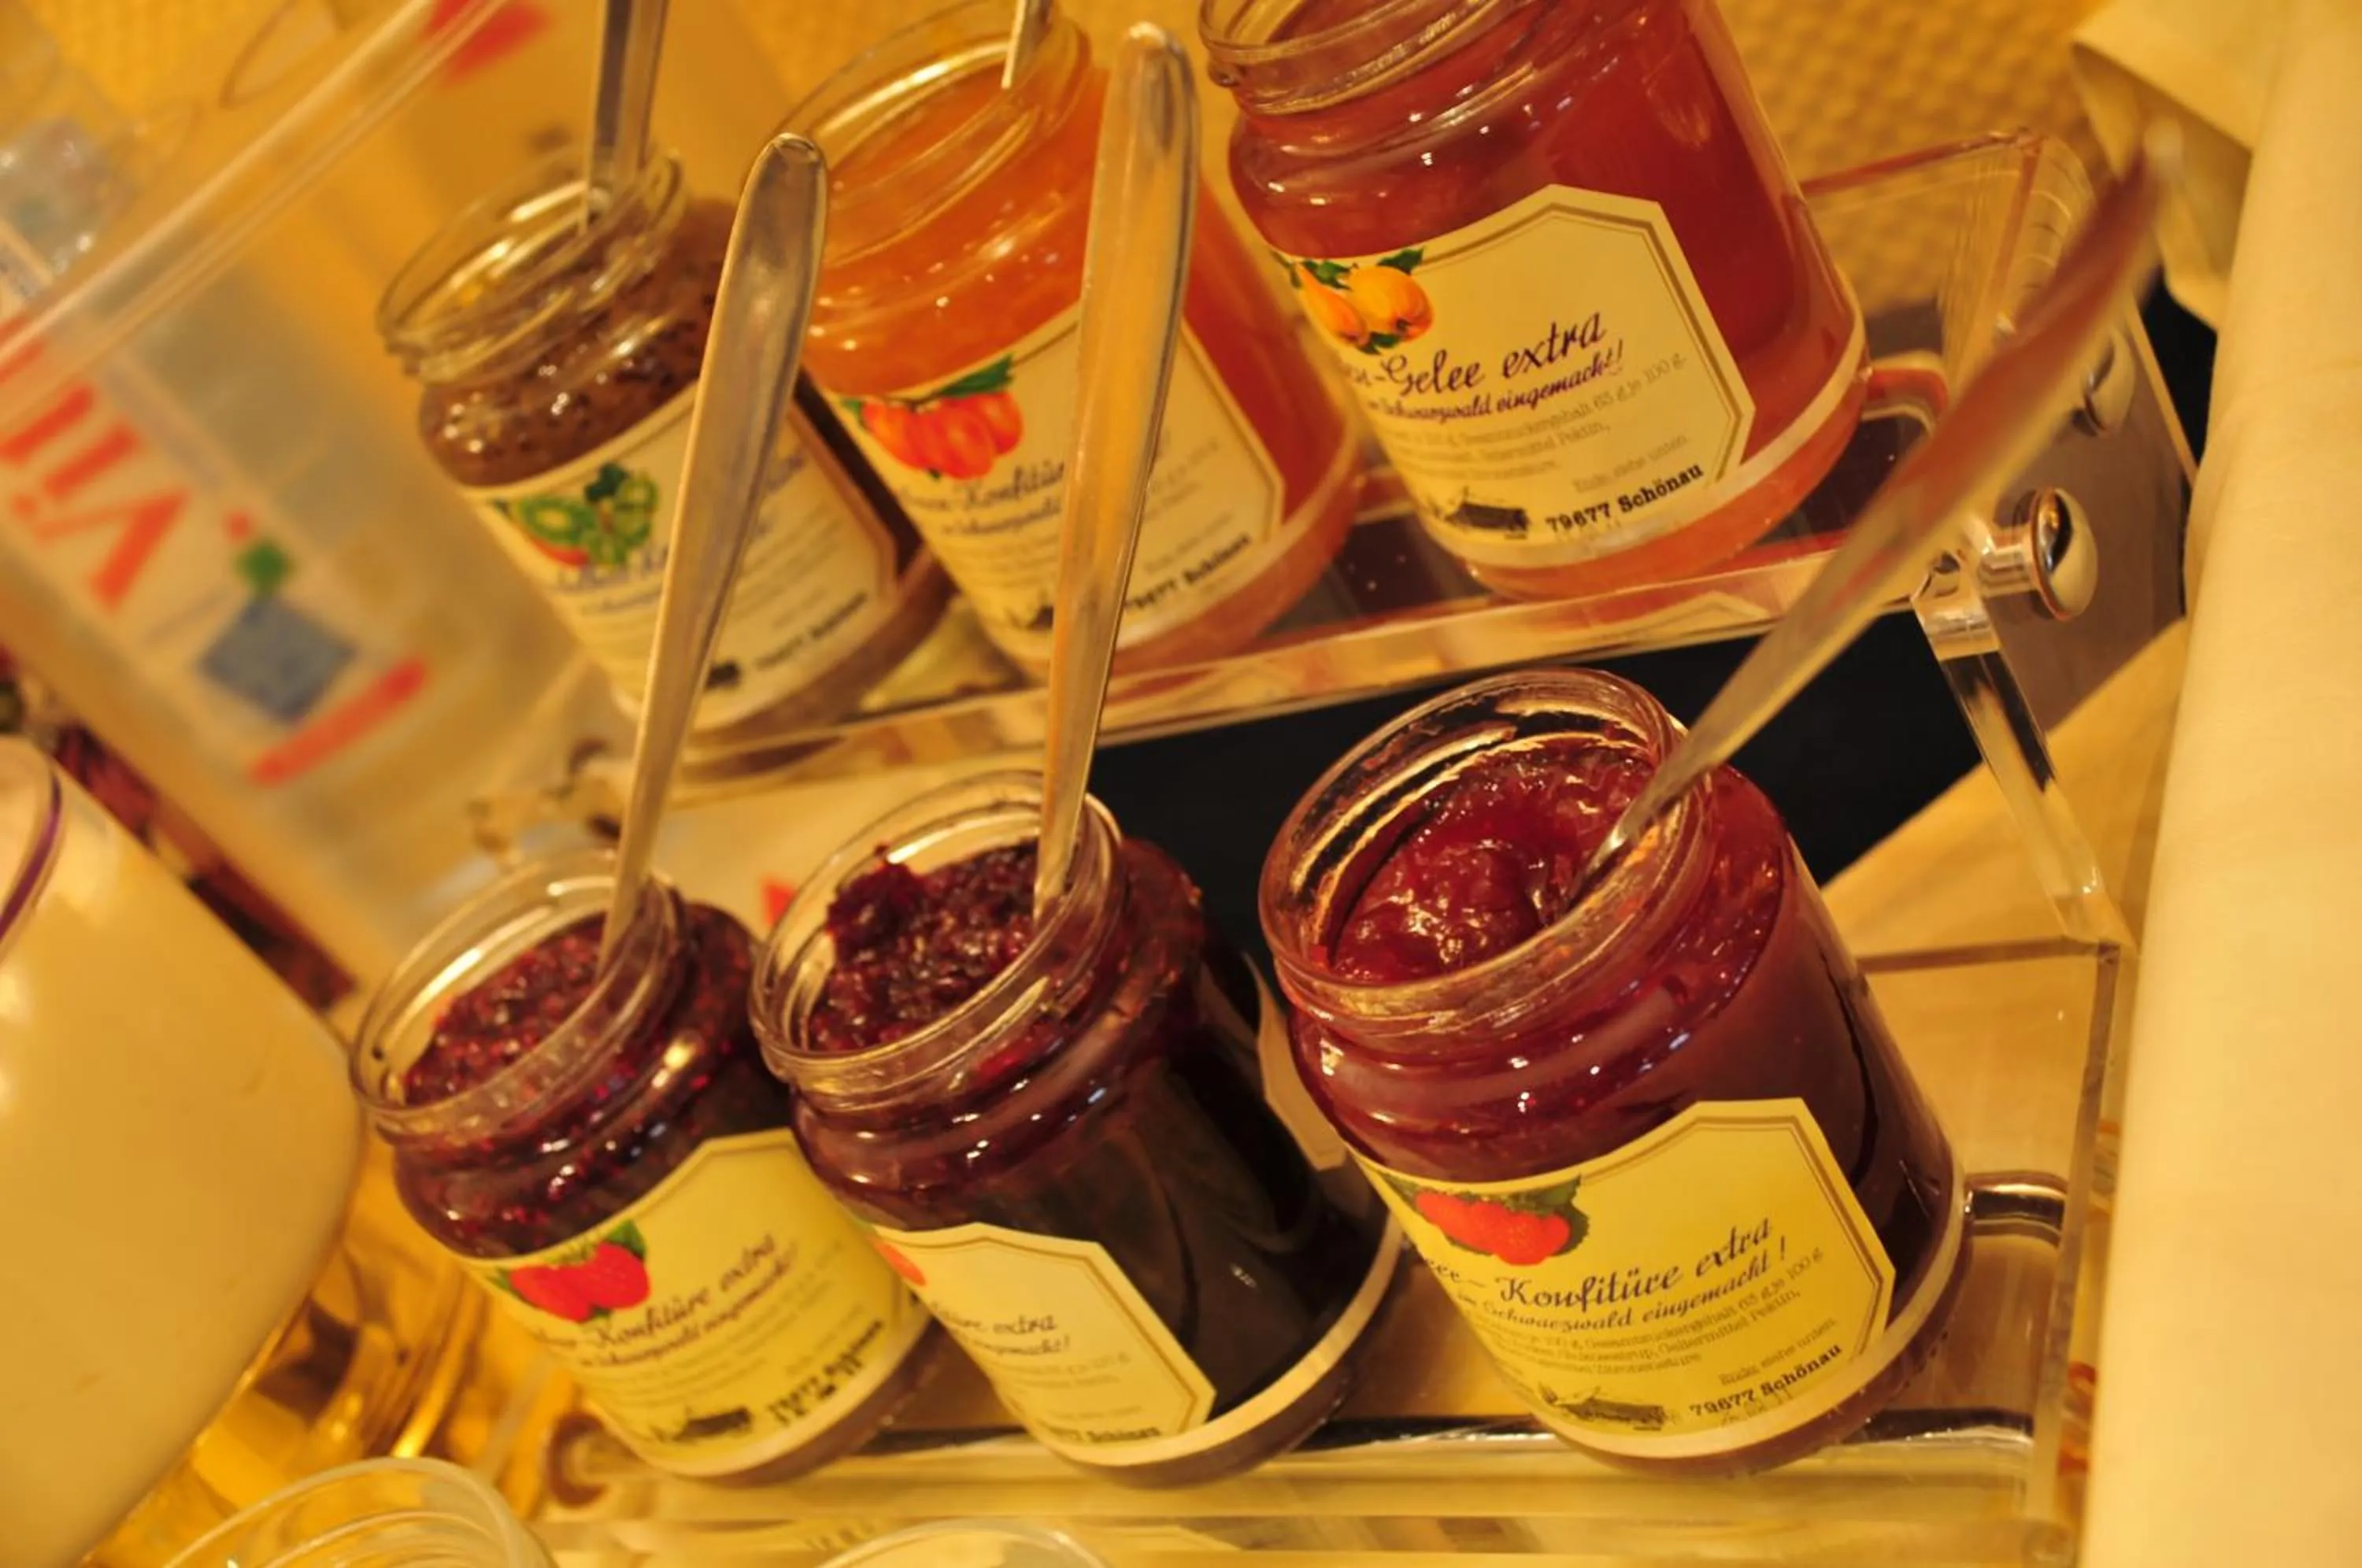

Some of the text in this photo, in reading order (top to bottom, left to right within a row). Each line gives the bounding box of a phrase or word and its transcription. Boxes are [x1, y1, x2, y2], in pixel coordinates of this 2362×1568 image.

[1501, 312, 1607, 379] extra
[1545, 501, 1612, 534] 79677
[1617, 463, 1705, 513] Schönau
[1495, 1265, 1683, 1313] Konfitüre
[1695, 1217, 1772, 1278] extra
[1689, 1387, 1756, 1417] 79677
[1759, 1343, 1842, 1396] Schönau
